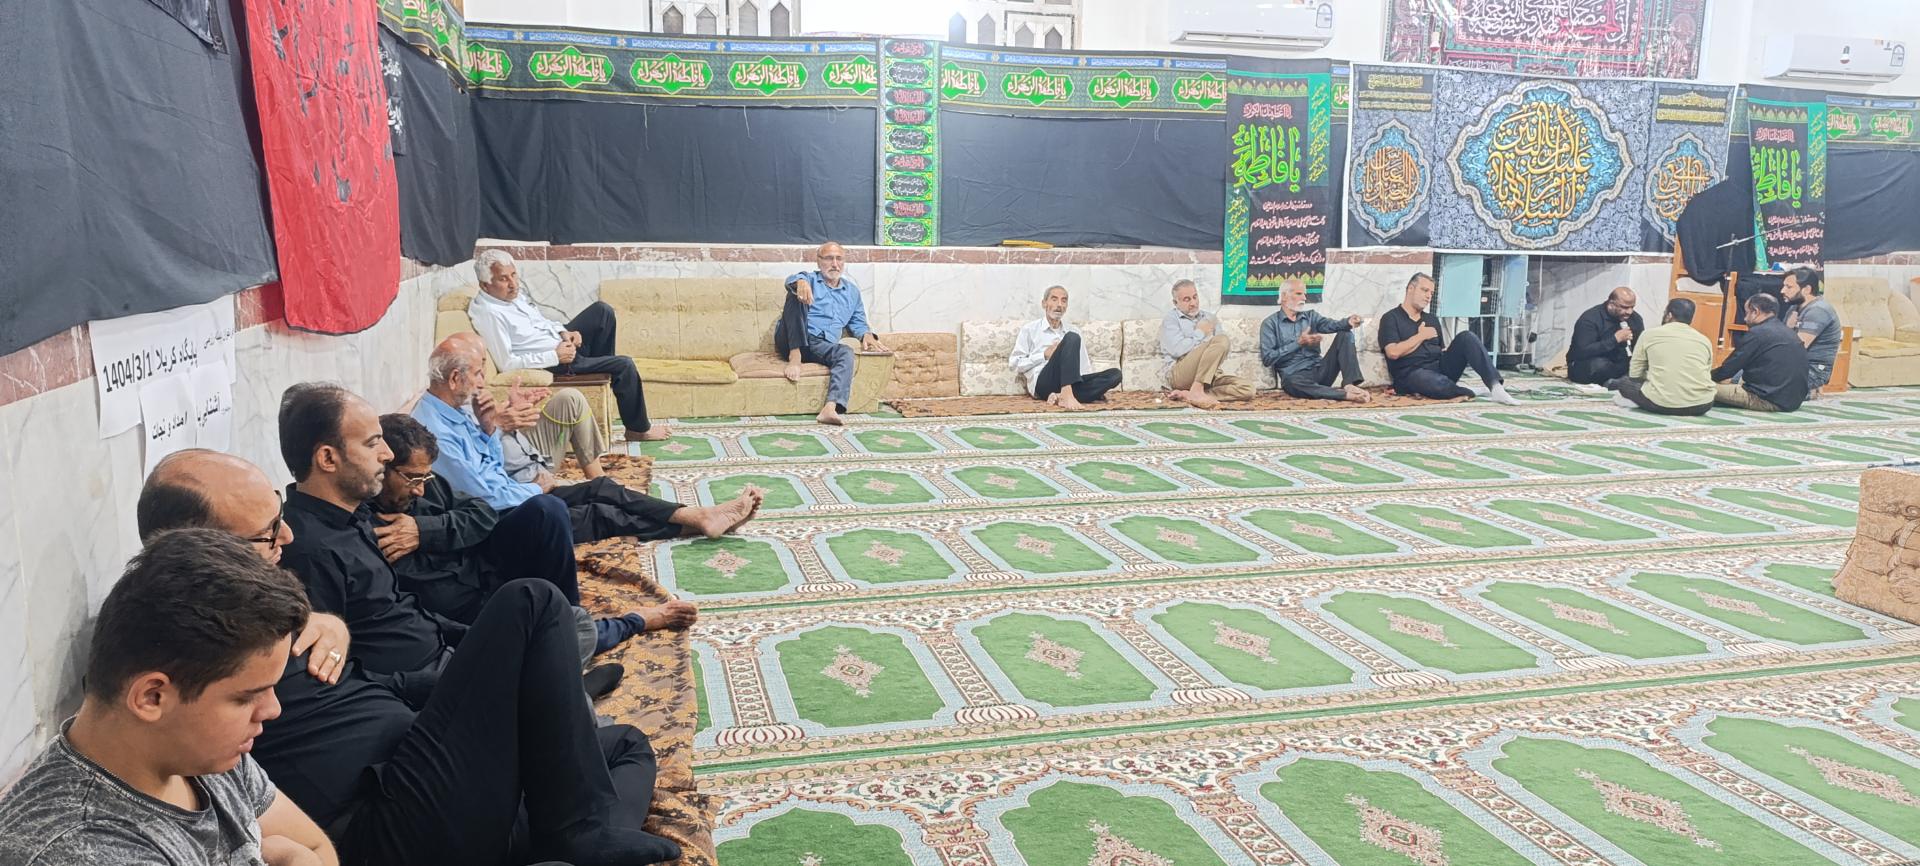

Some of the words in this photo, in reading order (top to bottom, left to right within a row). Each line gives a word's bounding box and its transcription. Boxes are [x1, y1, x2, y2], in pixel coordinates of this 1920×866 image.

[862, 64, 878, 84] طمة
[103, 351, 153, 393] 1404/3/1
[155, 345, 177, 373] کربلا
